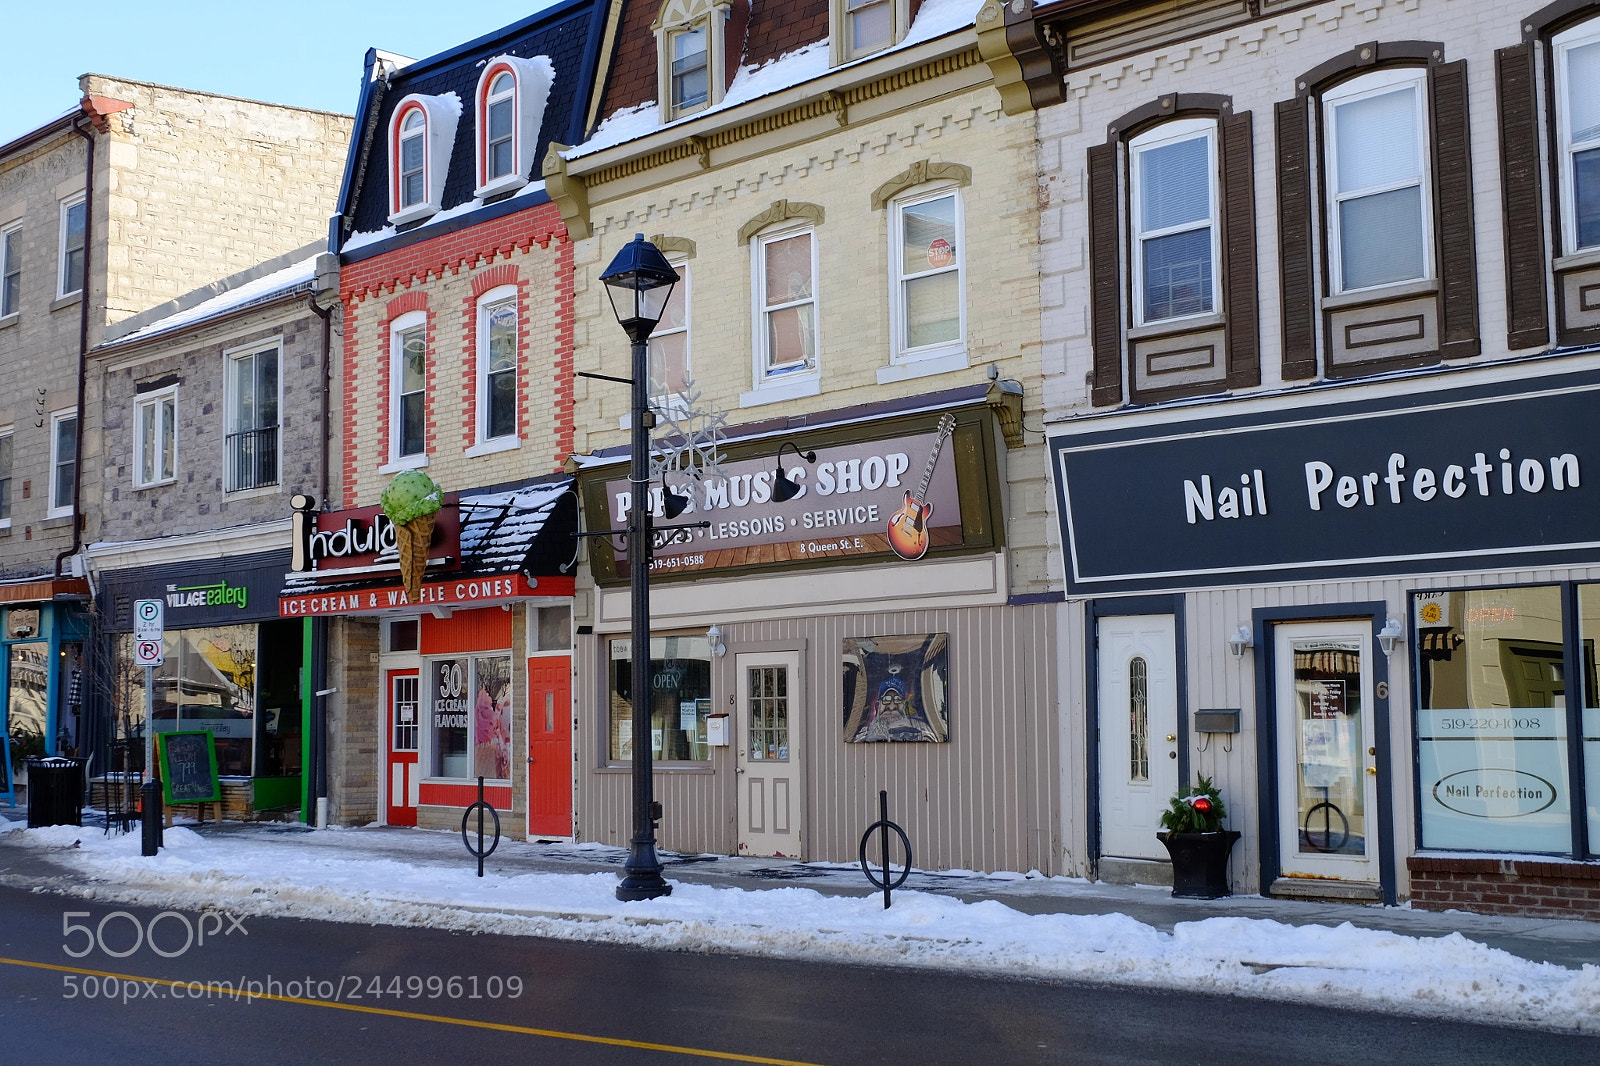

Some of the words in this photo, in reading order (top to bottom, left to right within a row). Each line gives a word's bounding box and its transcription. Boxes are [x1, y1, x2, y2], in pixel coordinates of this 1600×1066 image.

[929, 246, 950, 256] STOP
[815, 452, 910, 496] SHOP
[1183, 468, 1268, 524] Nail
[1304, 448, 1580, 511] Perfection
[709, 515, 785, 540] LESSONS
[802, 504, 879, 529] SERVICE
[800, 543, 805, 553] 8
[808, 541, 837, 554] Queen
[840, 539, 852, 551] St.
[855, 538, 864, 549] E.
[166, 591, 207, 607] VILLAGE
[207, 580, 248, 609] eatery
[283, 600, 307, 614] ICE
[310, 594, 360, 612] CREAM
[369, 593, 377, 607] &
[387, 586, 445, 605] WAFLE
[455, 579, 512, 599] CONES
[1465, 607, 1515, 622] OPEN
[440, 663, 462, 697] 30
[653, 674, 679, 689] OPEN
[1376, 682, 1389, 699] 6
[435, 700, 445, 712] ICE
[729, 694, 735, 705] 8
[435, 715, 468, 728] FLAVOURS
[1442, 718, 1541, 730] 519-220-1008
[1446, 785, 1470, 797] Nail
[1475, 785, 1543, 799] Perfection
